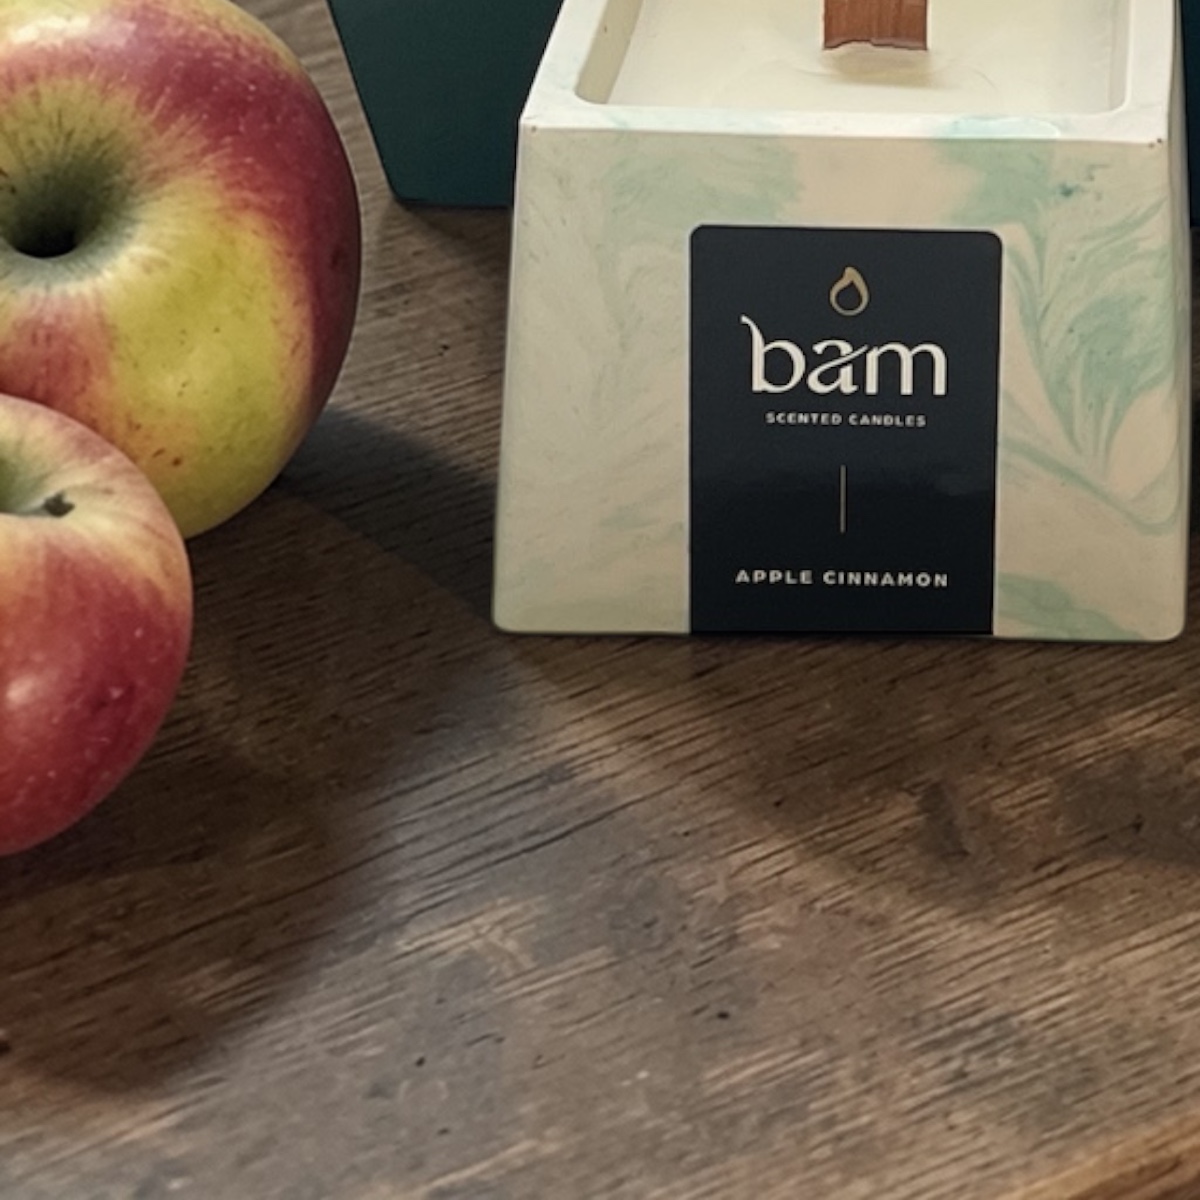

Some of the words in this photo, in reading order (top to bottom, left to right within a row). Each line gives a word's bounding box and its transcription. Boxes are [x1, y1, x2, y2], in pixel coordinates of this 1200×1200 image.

[740, 314, 948, 396] bam
[766, 411, 843, 426] SCENTED
[848, 412, 928, 428] CANDLES
[735, 569, 813, 585] APPLE
[822, 570, 949, 587] CINNAMON
